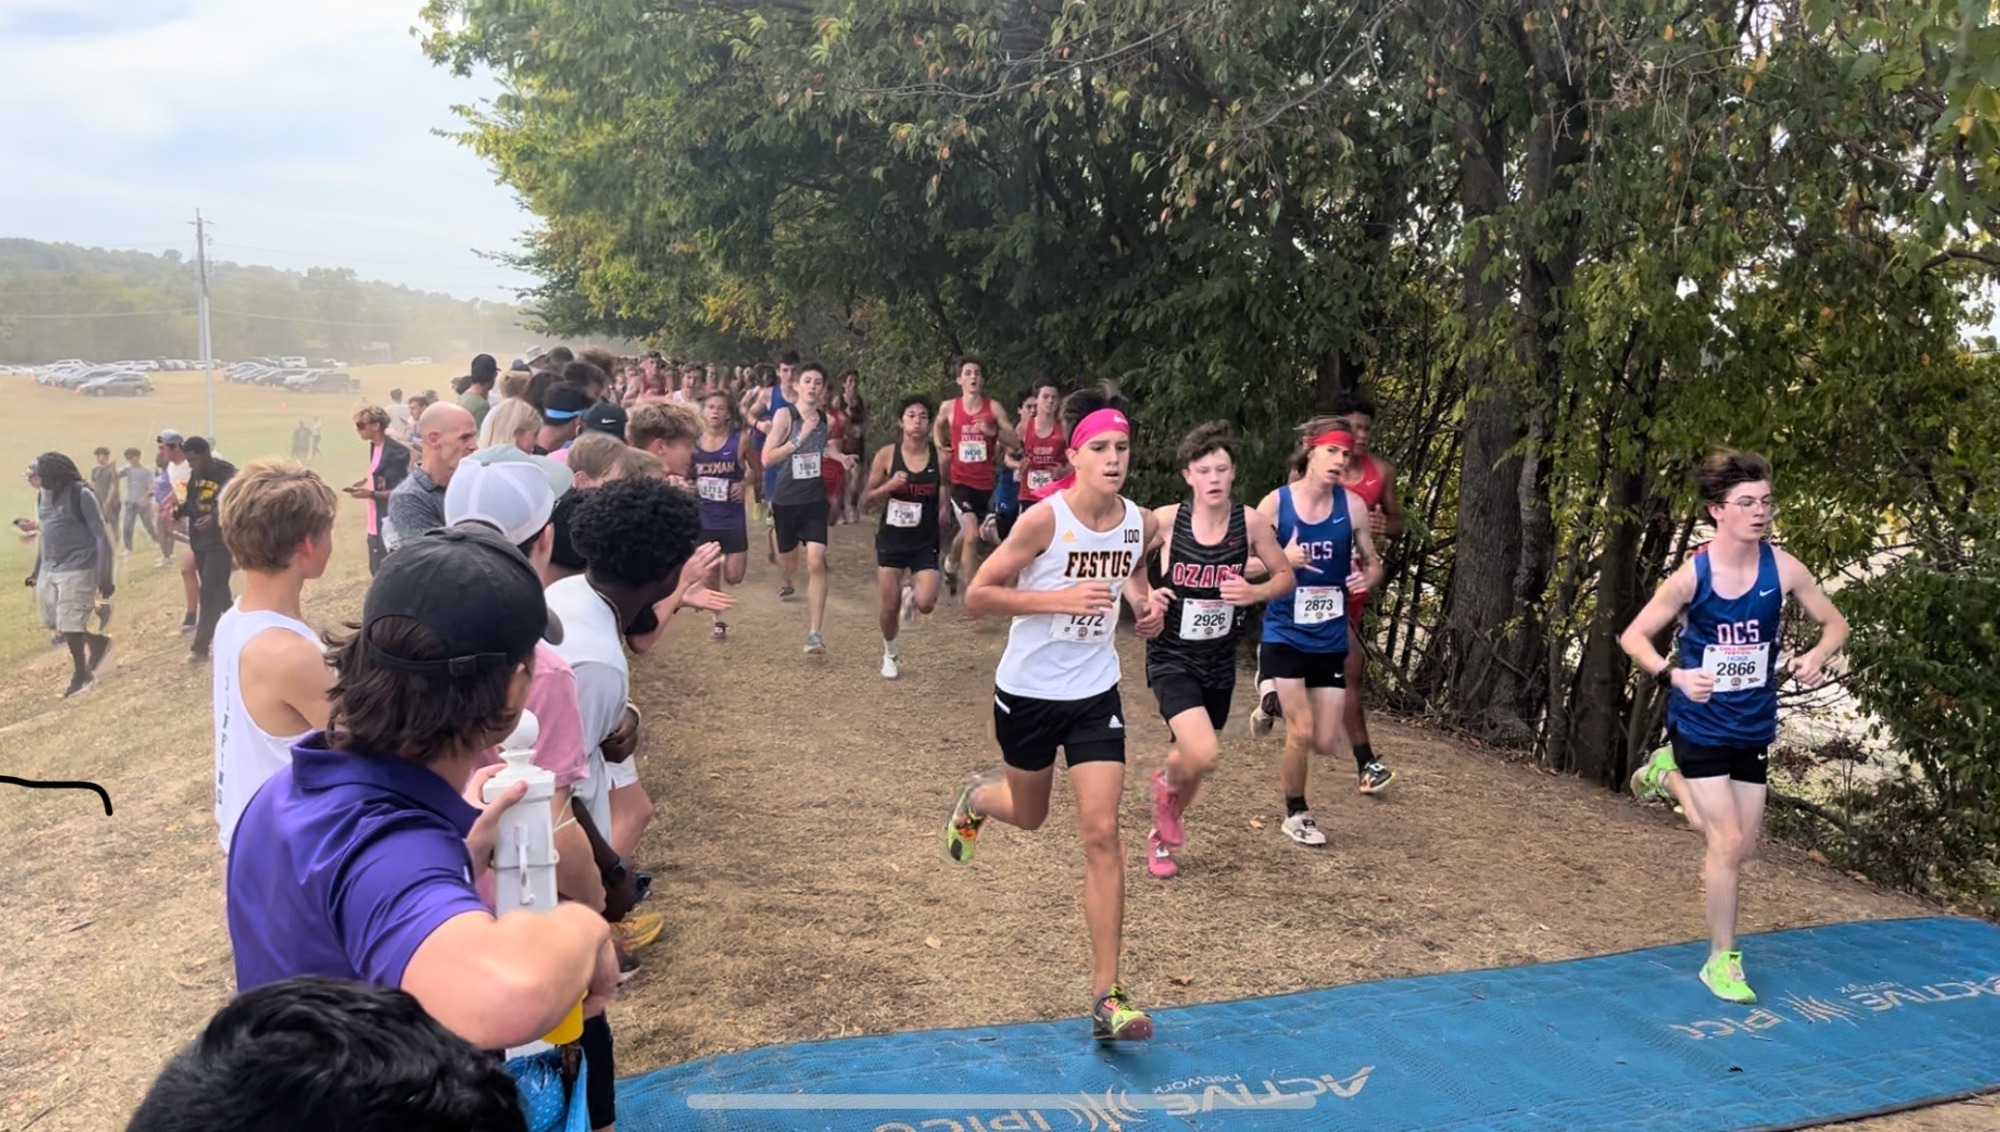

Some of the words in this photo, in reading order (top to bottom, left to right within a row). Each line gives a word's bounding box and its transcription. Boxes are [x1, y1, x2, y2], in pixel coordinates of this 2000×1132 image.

[1123, 528, 1140, 544] 100
[1063, 550, 1133, 578] FESTUS
[1304, 598, 1334, 612] 2873
[1070, 613, 1105, 627] 1272
[1193, 612, 1227, 627] 2926
[1716, 661, 1757, 677] 2866
[1153, 1073, 1242, 1094] network
[1156, 1065, 1376, 1116] ACTIVE
